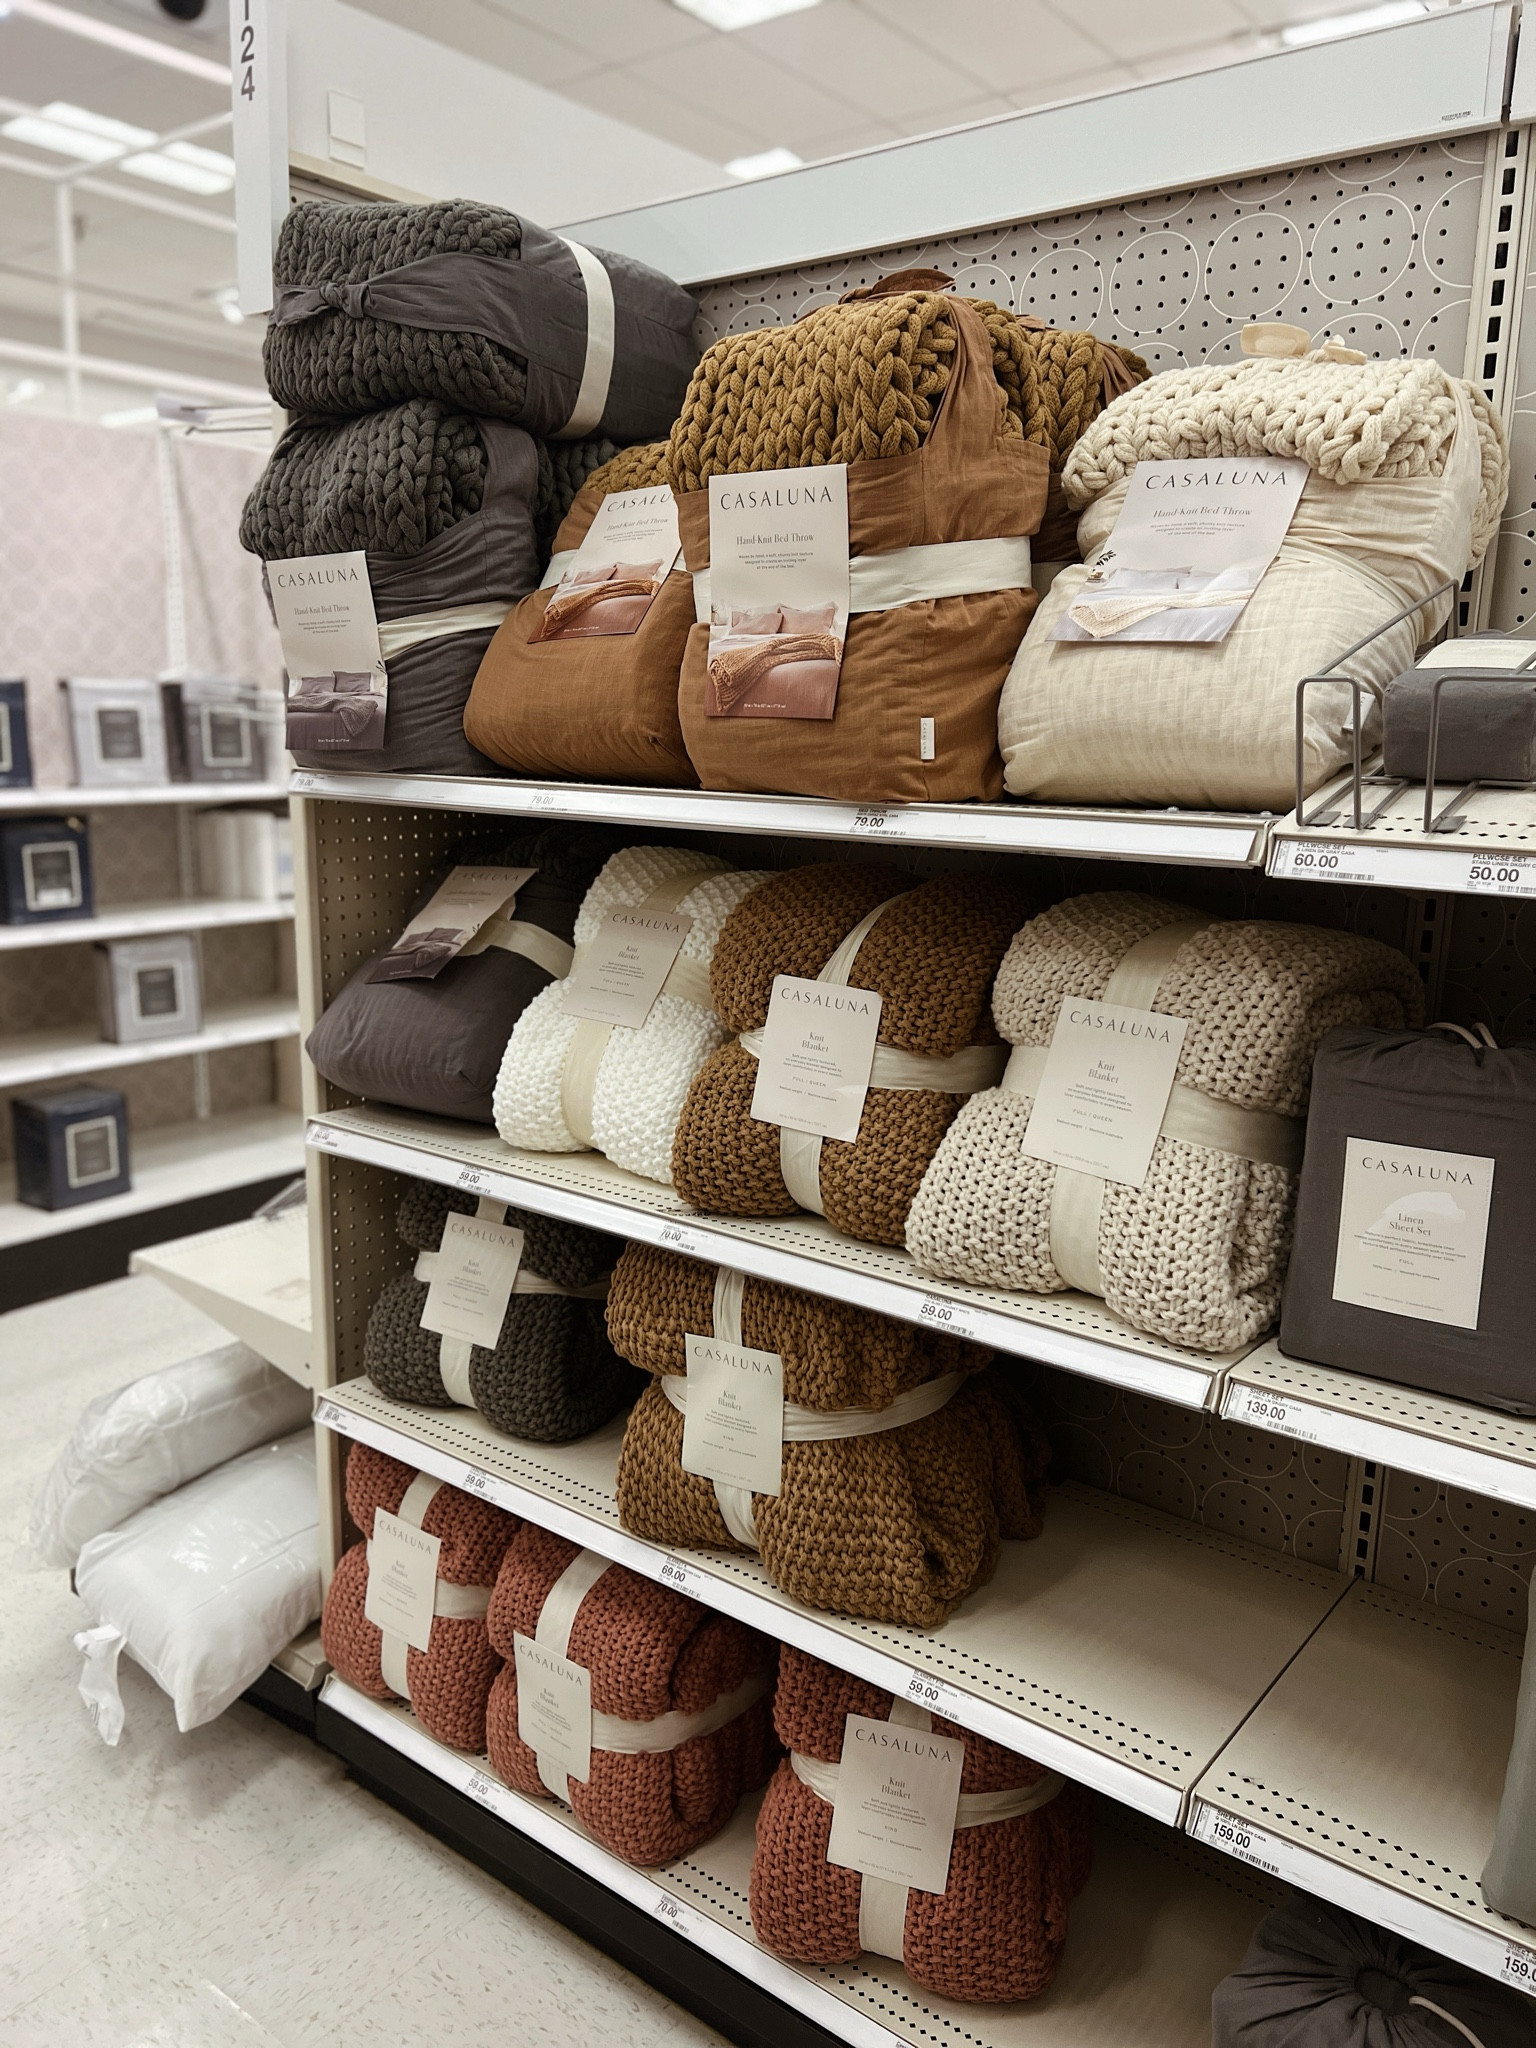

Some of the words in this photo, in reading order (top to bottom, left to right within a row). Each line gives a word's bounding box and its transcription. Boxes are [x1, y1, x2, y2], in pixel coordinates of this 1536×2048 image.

[1146, 471, 1287, 489] CASALUNA
[607, 492, 671, 512] CASALU
[720, 486, 832, 510] CASALUNA
[1153, 506, 1198, 518] Hand-Knit
[1200, 506, 1220, 515] Bed
[1222, 506, 1252, 516] Throw
[736, 534, 773, 546] Hand-Knit
[774, 533, 789, 544] Bed
[790, 532, 814, 542] Throw
[277, 567, 359, 588] CASALUNA
[321, 603, 332, 614] Bed
[333, 604, 350, 613] Throw
[531, 795, 554, 805] 79.00
[853, 816, 885, 828] 79.00
[1297, 842, 1331, 850] PLLWCSE
[1294, 853, 1339, 869] 60.00
[1472, 853, 1510, 862] PLLWCSE
[1512, 855, 1528, 863] SET
[1469, 866, 1520, 883] 50.00
[612, 913, 680, 933] CASALUNA
[781, 987, 869, 1015] CASALUNA
[1070, 1010, 1170, 1043] CASALUNA
[809, 1031, 825, 1043] Knit
[801, 1039, 829, 1053] Blanket
[1097, 1060, 1115, 1072] Knit
[1088, 1068, 1119, 1084] Blanket
[459, 1171, 480, 1184] 59.00
[1362, 1156, 1473, 1185] CASALUNA
[1398, 1212, 1424, 1225] Linen
[451, 1222, 515, 1248] CASALUNA
[1388, 1221, 1414, 1234] Sheet
[1416, 1224, 1432, 1237] Set
[920, 1303, 953, 1321] 59.00
[694, 1346, 773, 1376] CASALUNA
[723, 1390, 737, 1401] Knit
[1250, 1388, 1271, 1400] SHEET
[1271, 1394, 1284, 1402] SET
[717, 1397, 742, 1412] Blanket
[1247, 1399, 1286, 1421] 139.00
[465, 1474, 486, 1489] 59.00
[379, 1519, 432, 1555] CASALUNA
[661, 1564, 686, 1582] 69.00
[519, 1644, 583, 1686] CASALUNA
[909, 1679, 939, 1701] 59.00
[855, 1728, 952, 1763] CASALUNA
[468, 1778, 489, 1796] 59.00
[889, 1776, 906, 1789] Knit
[881, 1784, 911, 1800] Blanket
[1217, 1809, 1236, 1822] SHEET
[1236, 1819, 1250, 1829] SET
[1213, 1822, 1251, 1849] 159.00
[657, 1899, 678, 1918] 70.00
